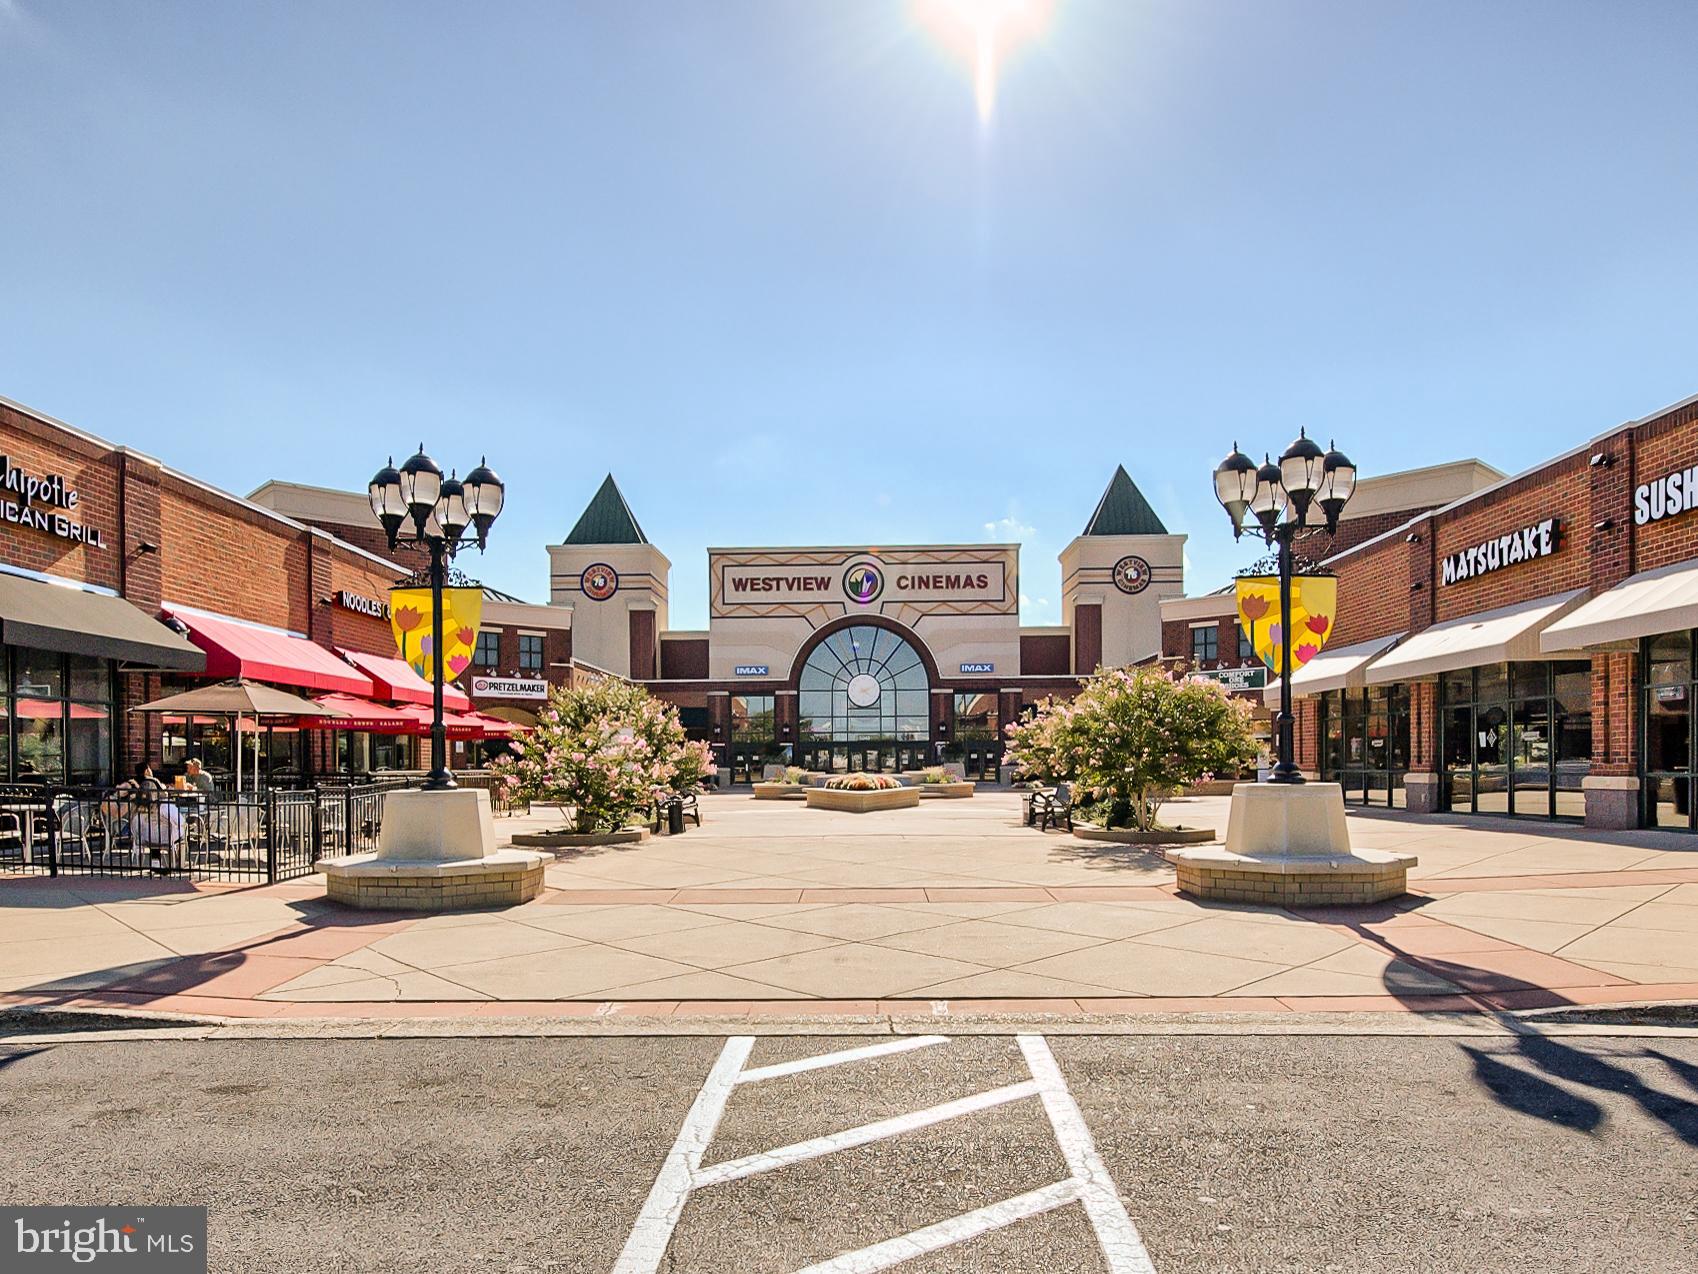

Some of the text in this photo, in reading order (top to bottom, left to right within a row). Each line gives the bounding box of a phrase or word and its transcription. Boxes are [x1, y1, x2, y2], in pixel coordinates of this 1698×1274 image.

[55, 514, 107, 549] GRILL
[1441, 519, 1553, 586] MATSUTAKE
[732, 574, 988, 592] WESTVIEW CINEMAS
[343, 591, 382, 618] NOODLES
[736, 667, 767, 675] IMAX
[961, 664, 992, 672] IMAX
[489, 682, 544, 693] PRETZELMAKER
